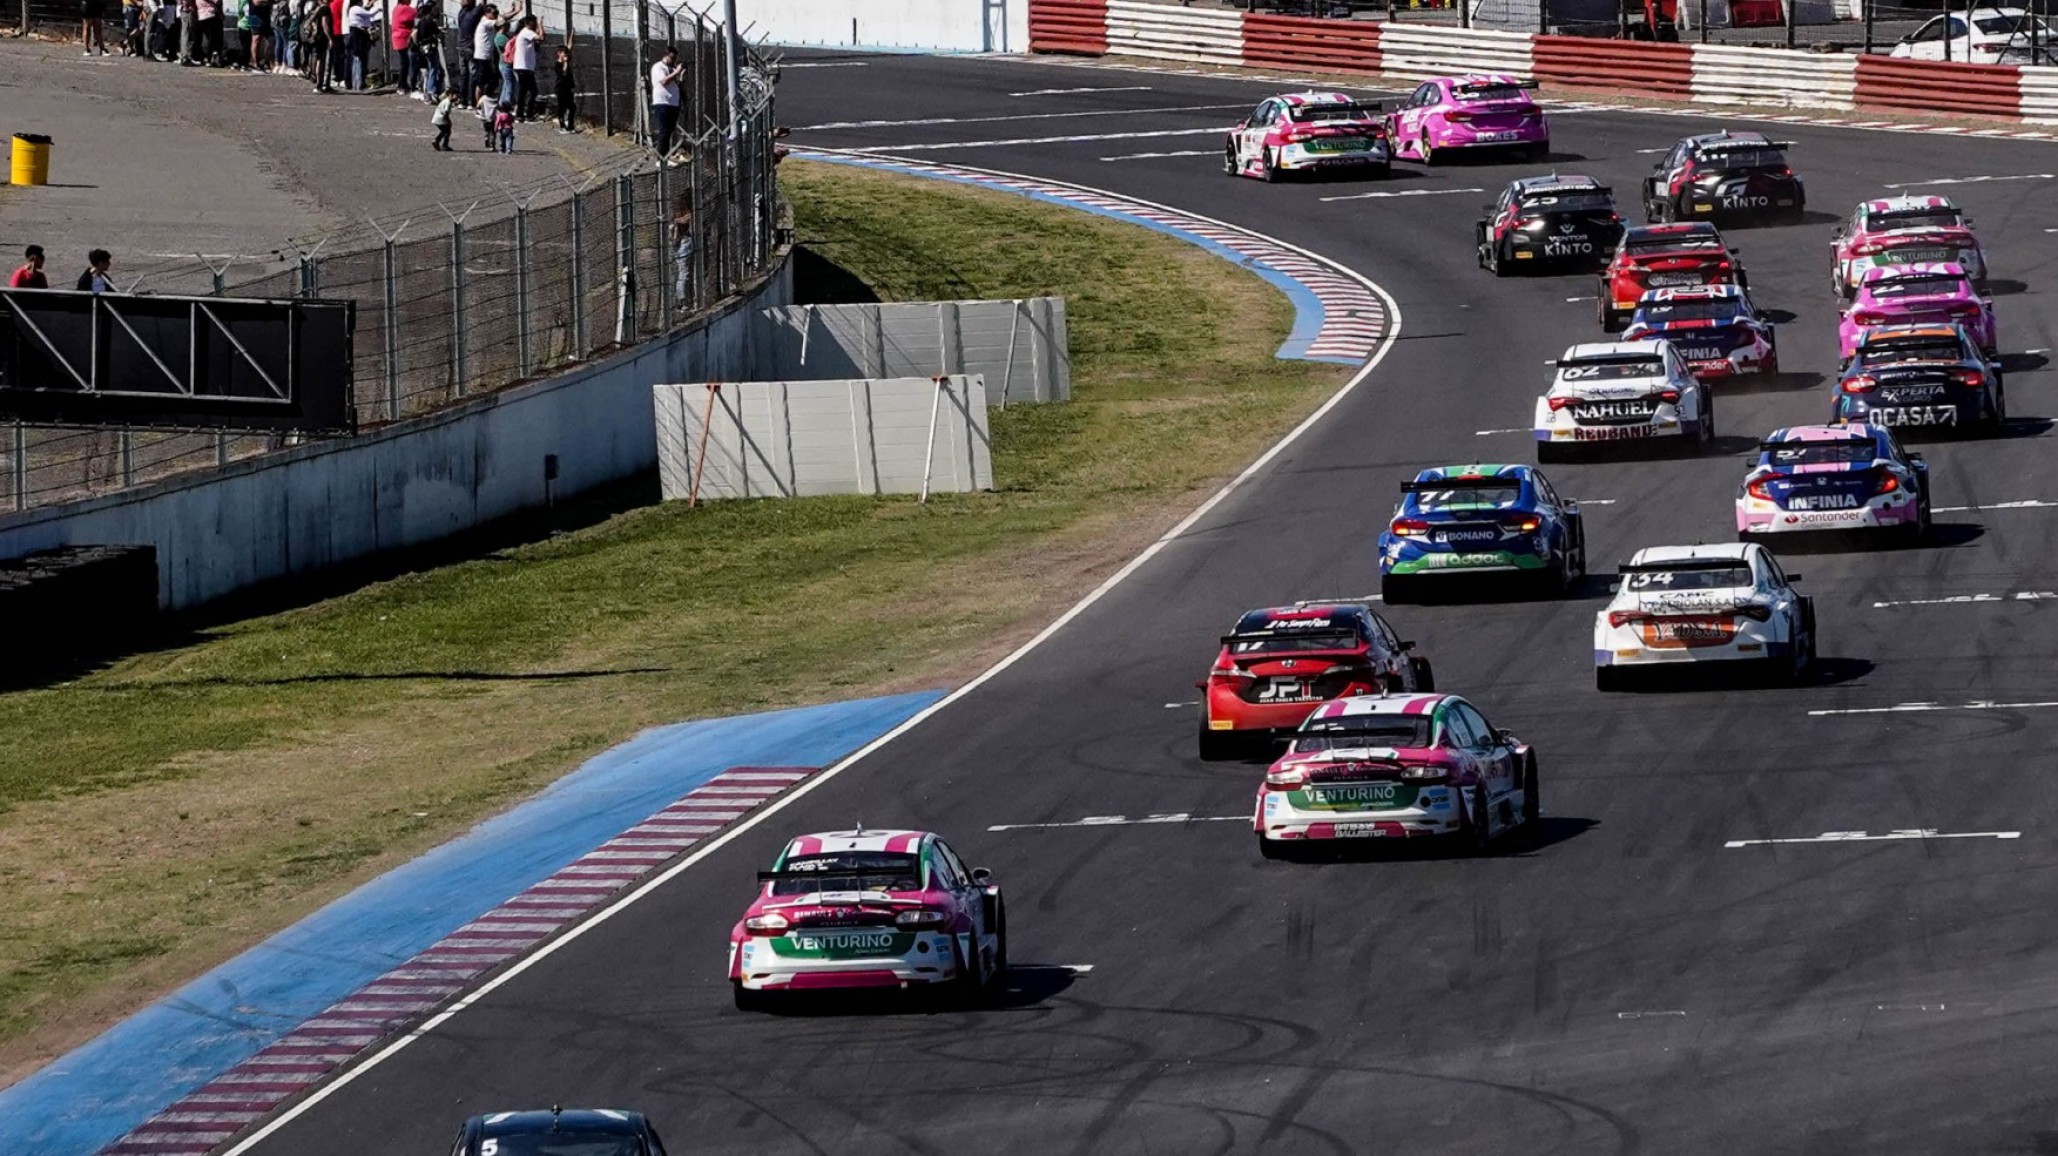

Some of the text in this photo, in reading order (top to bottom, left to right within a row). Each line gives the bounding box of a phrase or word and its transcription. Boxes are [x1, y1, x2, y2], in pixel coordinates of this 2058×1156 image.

[1573, 401, 1654, 419] NAHUEL
[1869, 406, 1936, 427] OCASA
[1788, 493, 1858, 510] INFINIA
[1801, 511, 1861, 523] Santander
[1449, 531, 1494, 542] BONANO
[1632, 572, 1674, 588] 34
[1258, 675, 1319, 699] JPT
[1305, 786, 1396, 803] VENTURINO
[791, 934, 893, 951] VENTURINO
[482, 1138, 498, 1156] 5
